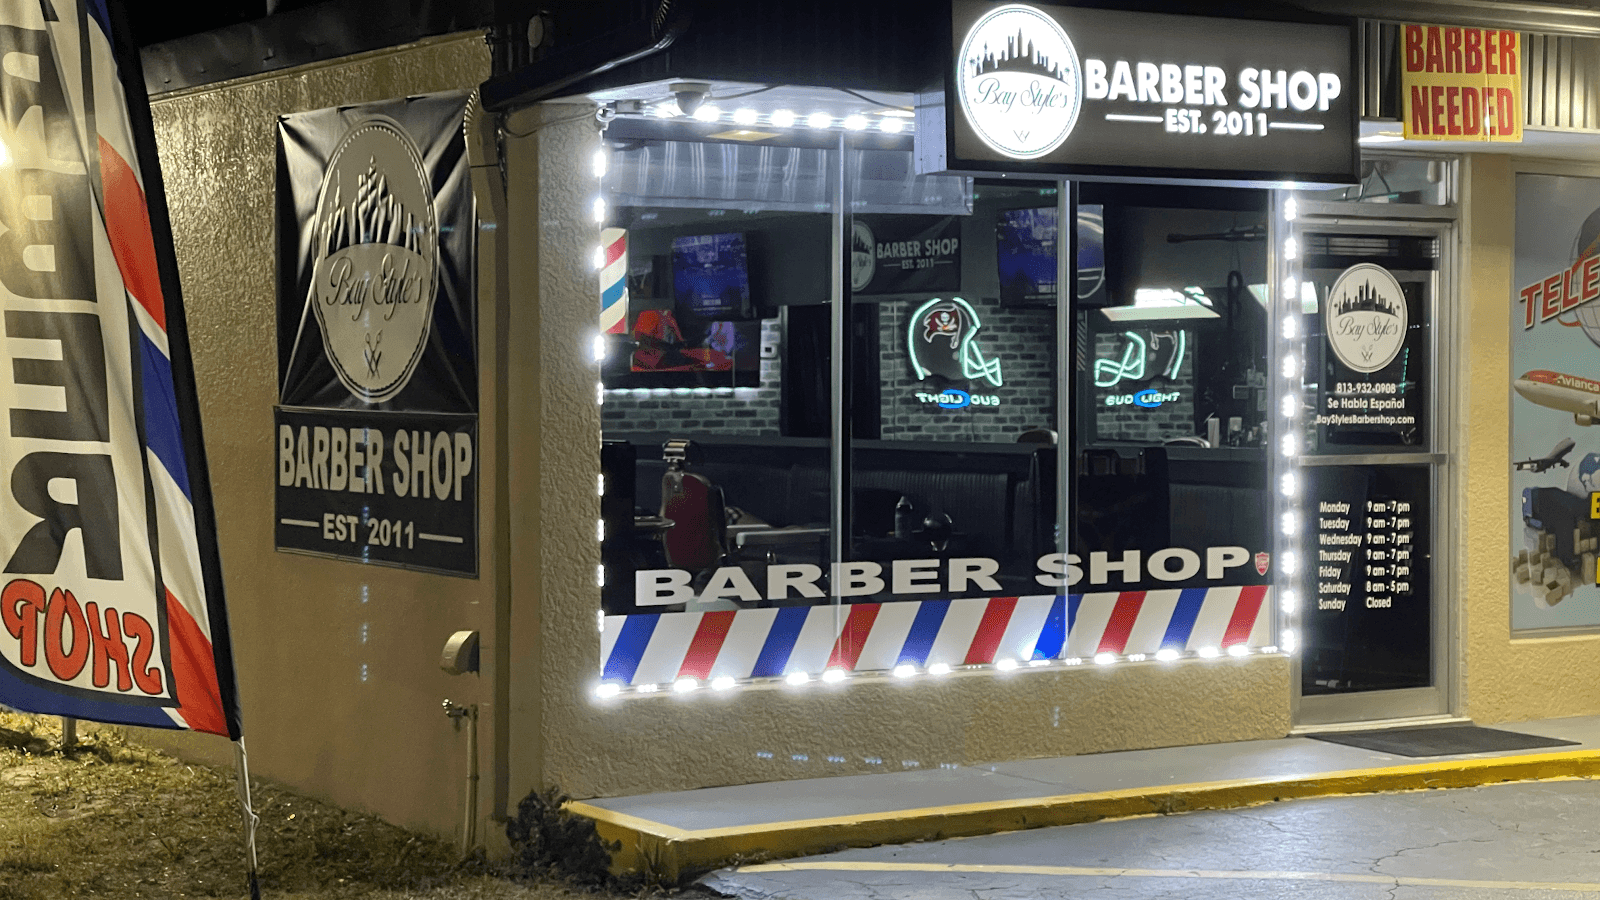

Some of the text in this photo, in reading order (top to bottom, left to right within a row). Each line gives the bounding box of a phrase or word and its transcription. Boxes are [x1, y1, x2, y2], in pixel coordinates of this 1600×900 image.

[1405, 25, 1517, 75] BARBER
[1085, 58, 1341, 111] BARBER SHOP
[973, 77, 1068, 115] Bay Style's
[1411, 85, 1515, 136] NEEDED
[1165, 109, 1269, 137] EST. 2011
[876, 238, 959, 259] BARBER SHOP
[917, 258, 935, 268] 2011
[326, 253, 422, 321] Bay Style's
[1520, 255, 1600, 330] TELE
[1336, 315, 1398, 341] Bay Style's
[1336, 382, 1397, 394] 813-932-0908
[1557, 374, 1600, 392] Avianca
[1105, 392, 1180, 406] BUD LIGHT
[1327, 397, 1405, 411] Se Habla Español
[1316, 414, 1415, 426] BayStylesBarbershop.com
[279, 424, 472, 501] BARBER SHOP
[1320, 501, 1350, 515] Monday
[1367, 501, 1372, 512] 9
[1373, 503, 1386, 512] am
[1392, 501, 1397, 511] 7
[1397, 503, 1410, 514] pm
[323, 513, 414, 549] EST 2011
[1320, 517, 1350, 531] Tuesday
[1367, 517, 1372, 528] 9
[1373, 519, 1386, 528] am
[1391, 517, 1397, 527] 7
[1397, 519, 1410, 530] pm
[1319, 533, 1362, 547] Wednesday
[1366, 533, 1372, 544] 9
[1372, 535, 1386, 544] am
[1391, 533, 1396, 543] 7
[1396, 535, 1410, 546] pm
[1319, 549, 1351, 563] Thursday
[1366, 549, 1371, 560] 9
[1372, 551, 1385, 560] am
[1391, 549, 1396, 559] 7
[1396, 551, 1409, 562] pm
[635, 557, 1002, 606] BARBER
[1035, 546, 1250, 588] SHOP
[1319, 566, 1341, 579] Friday
[1366, 565, 1371, 576] 9
[1372, 567, 1385, 576] am
[1390, 565, 1396, 575] 7
[1396, 567, 1409, 578] pm
[1319, 582, 1351, 595] Saturday
[1366, 581, 1371, 592] 8
[1372, 583, 1385, 592] am
[1390, 581, 1396, 591] 5
[1396, 583, 1409, 594] pm
[1319, 597, 1392, 611] Sunday Closed
